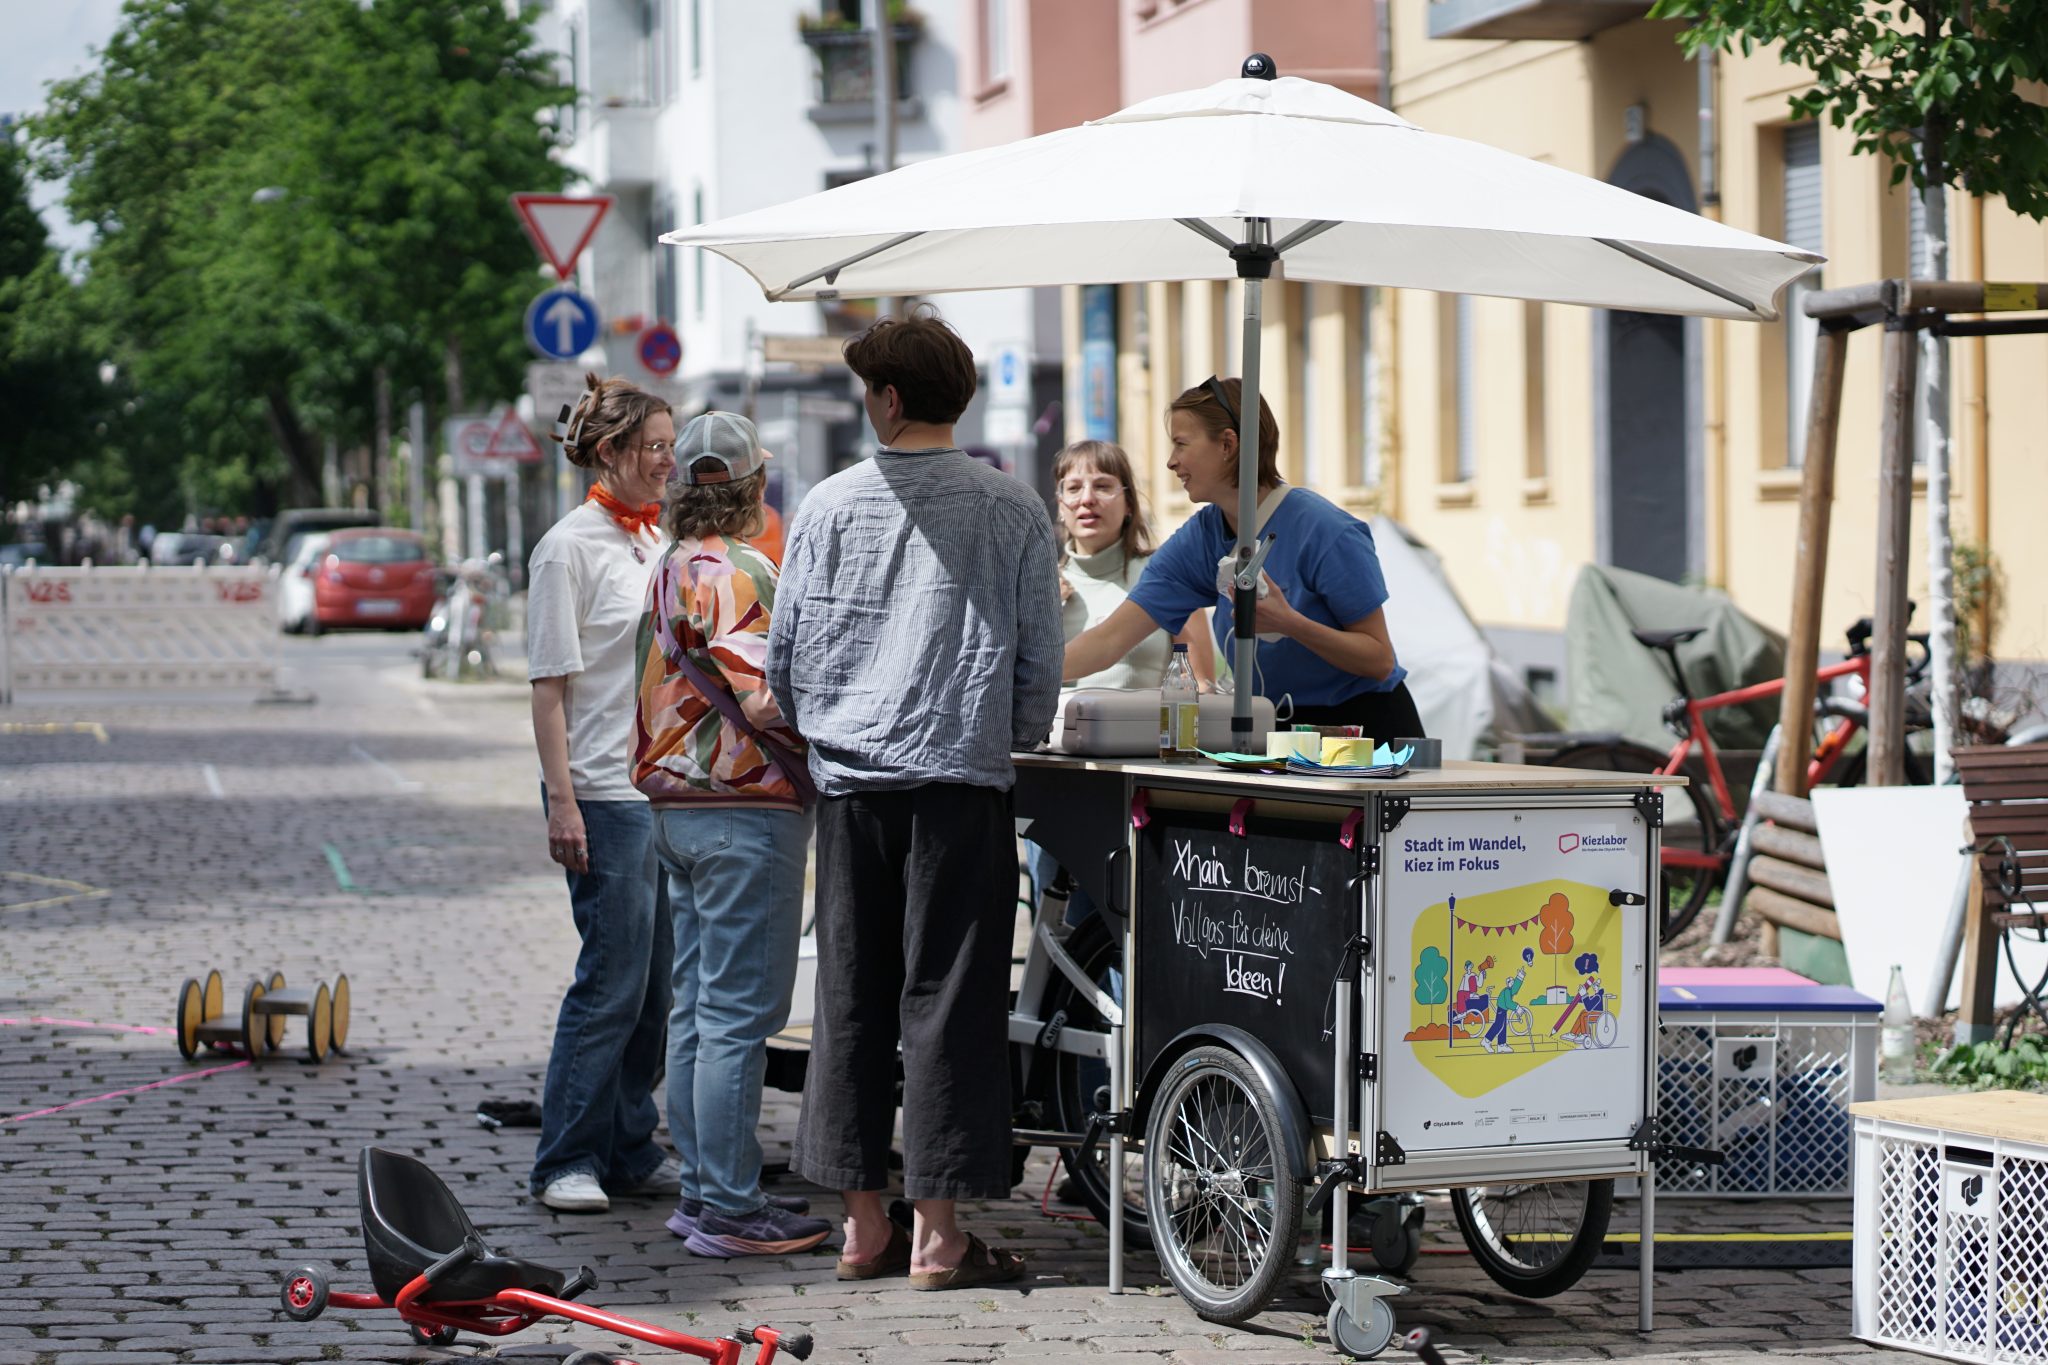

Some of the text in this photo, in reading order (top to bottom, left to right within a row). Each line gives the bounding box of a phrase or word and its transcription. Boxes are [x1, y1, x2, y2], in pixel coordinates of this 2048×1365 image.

[1404, 835, 1526, 852] Stadt im Wandel,
[1581, 834, 1628, 846] Kiezlabor
[1173, 839, 1232, 888] Xhain
[1404, 856, 1500, 873] Kiez im Fokus
[1171, 899, 1225, 960] Vollgas
[1252, 913, 1295, 955] deine
